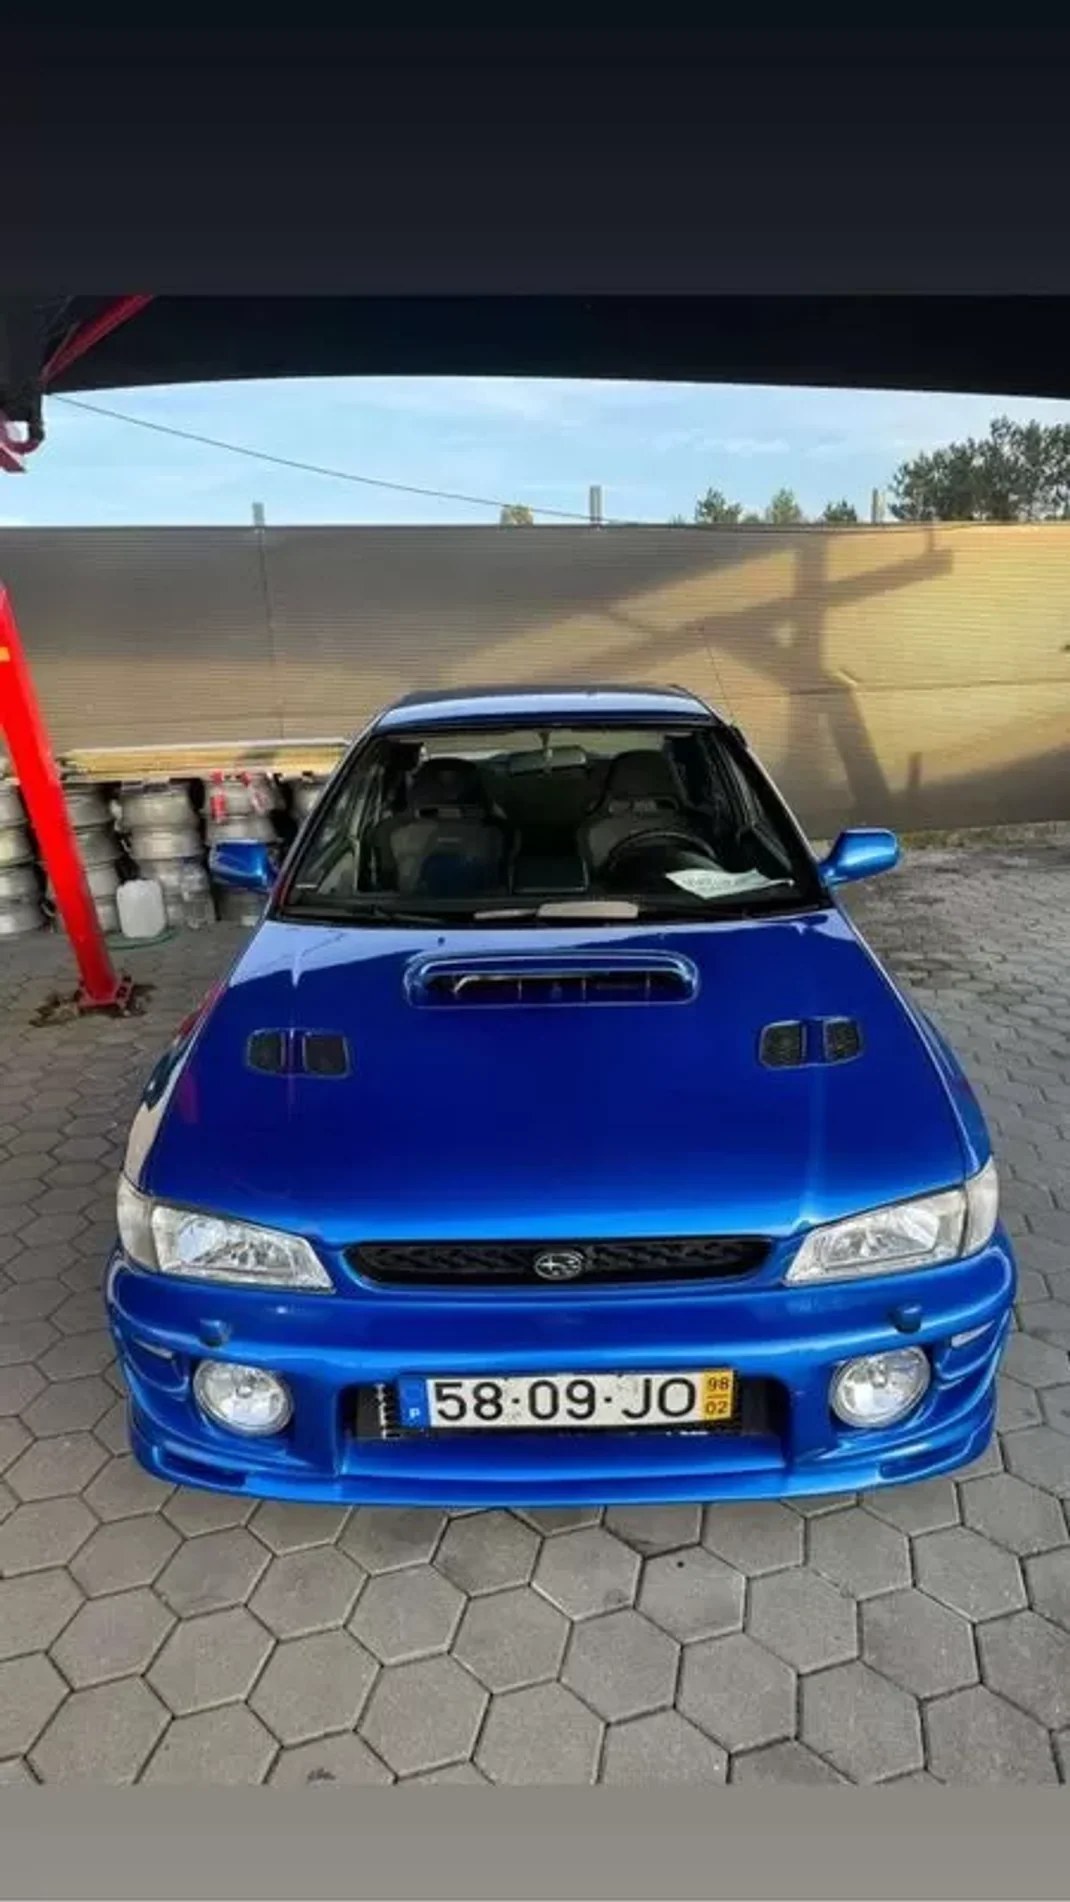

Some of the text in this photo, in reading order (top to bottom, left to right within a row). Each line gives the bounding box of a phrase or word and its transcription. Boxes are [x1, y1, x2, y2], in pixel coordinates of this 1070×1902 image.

[707, 1376, 729, 1391] 98
[410, 1408, 420, 1419] P
[705, 1400, 728, 1415] 02
